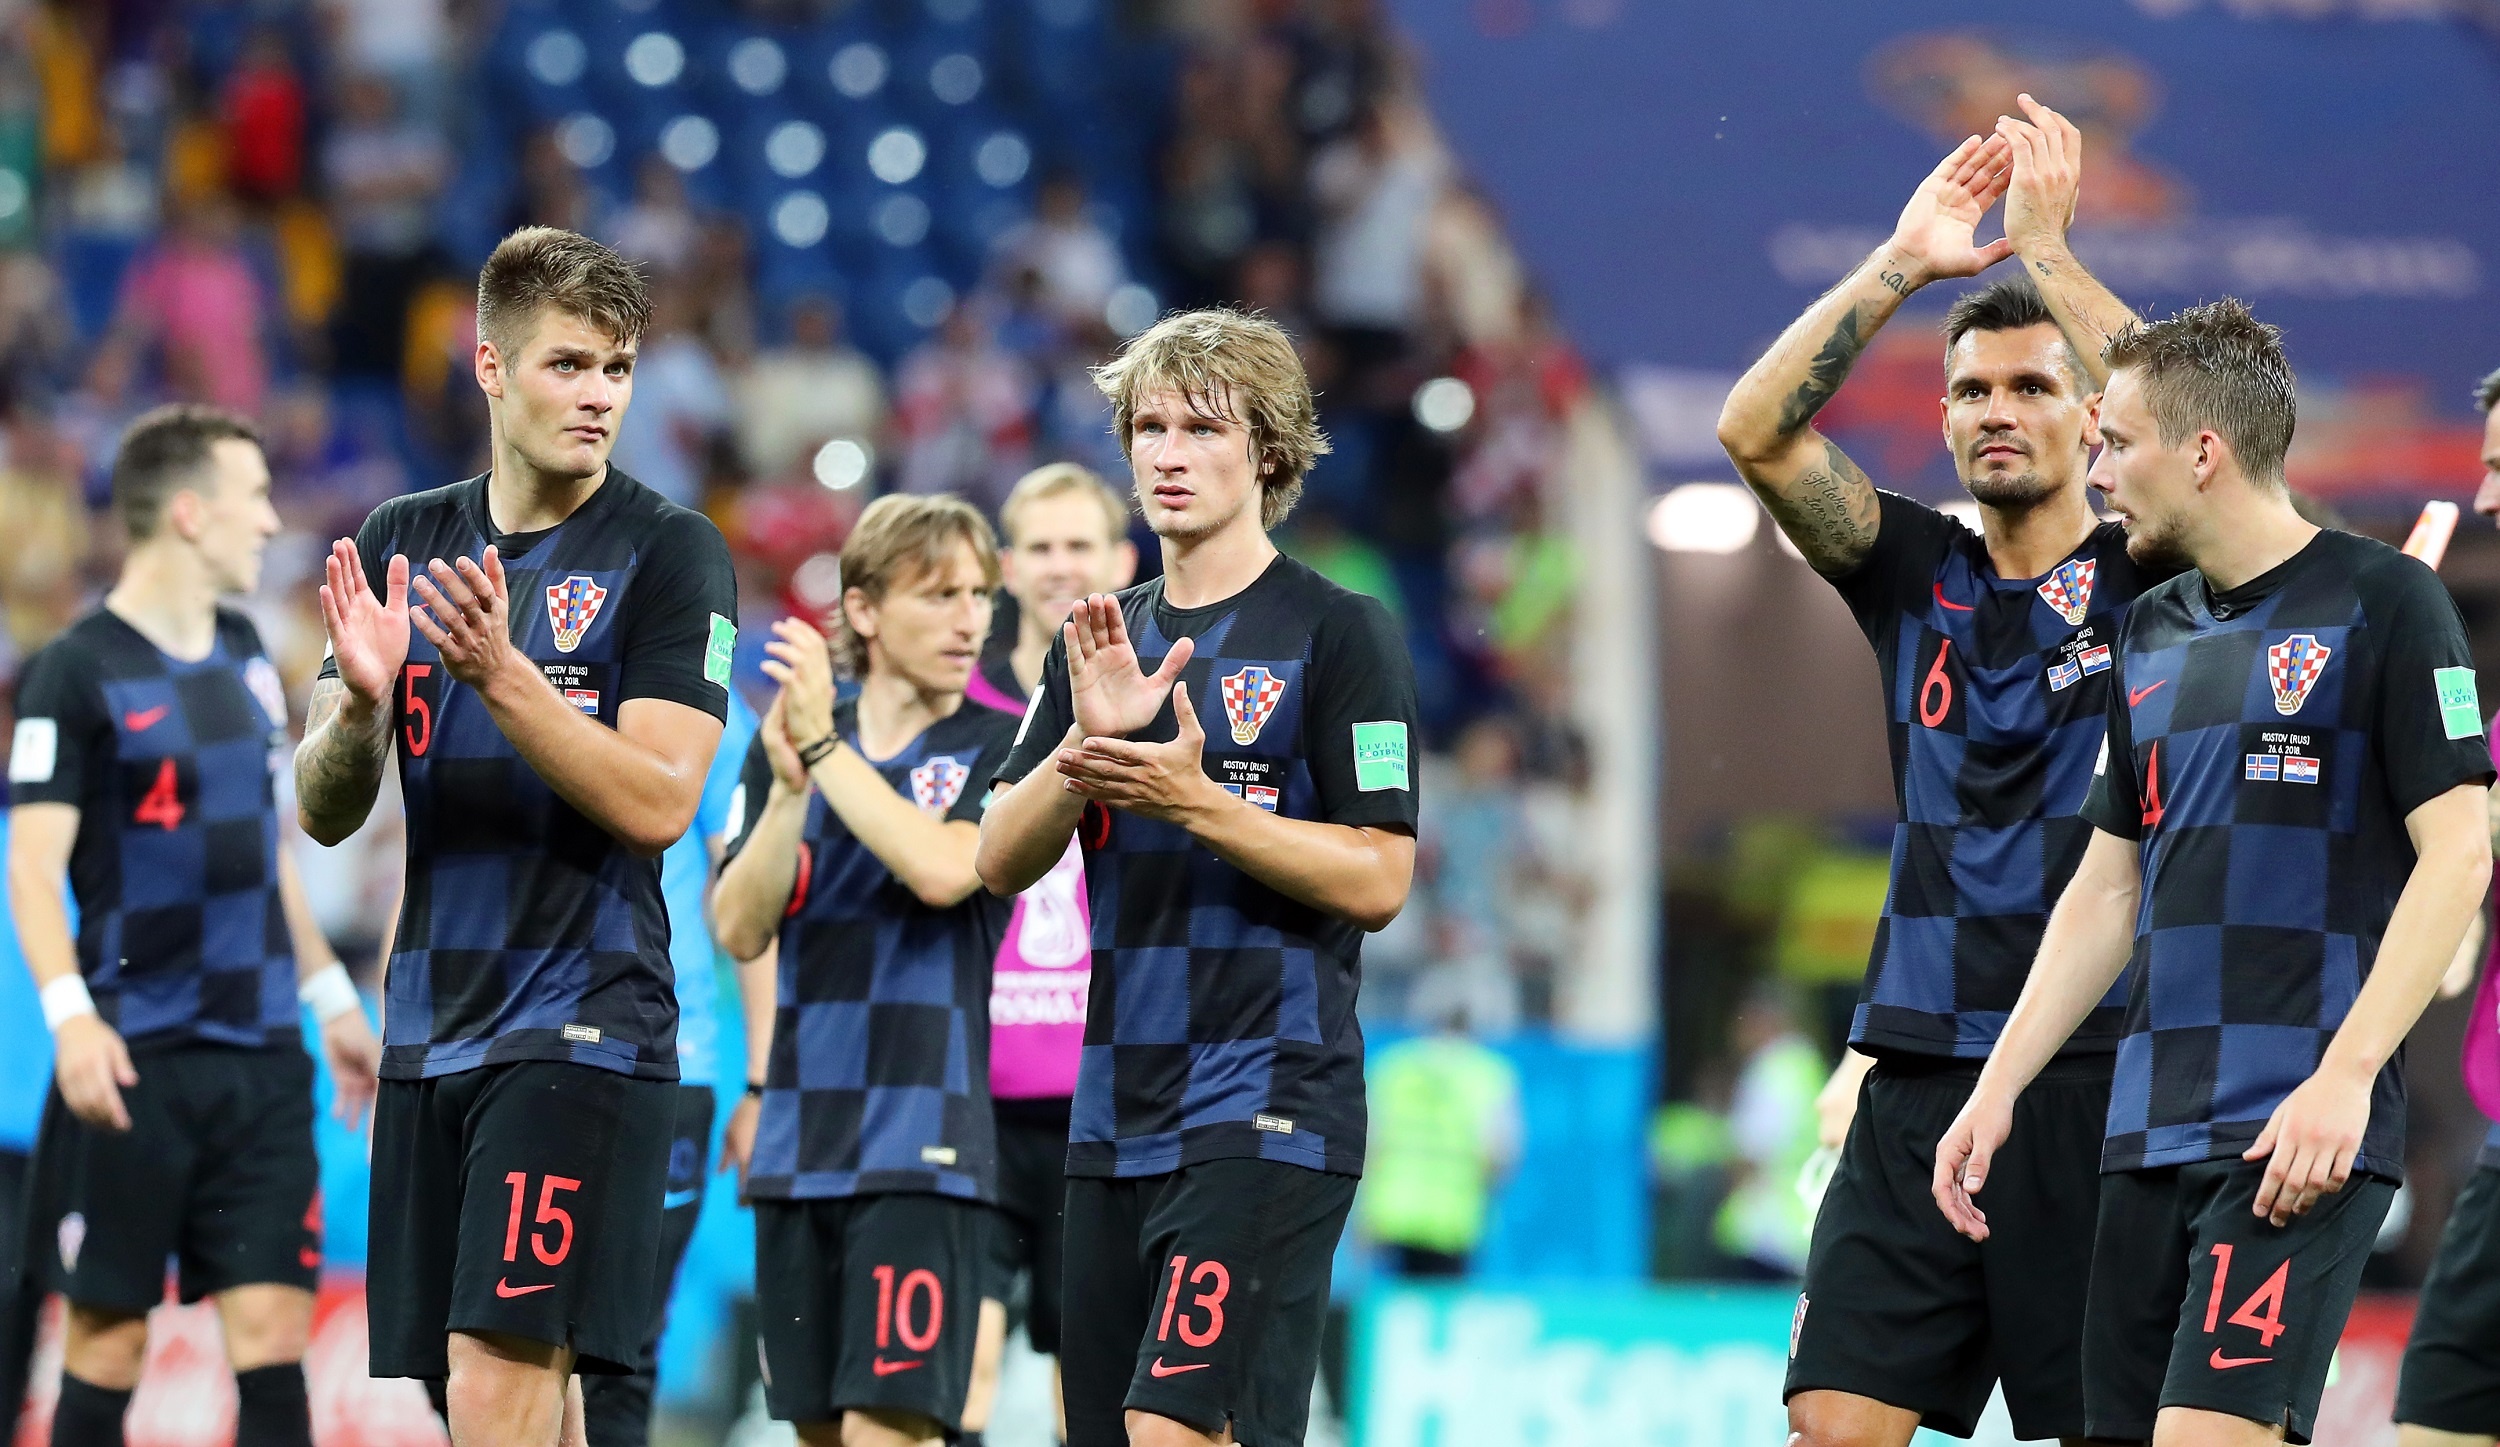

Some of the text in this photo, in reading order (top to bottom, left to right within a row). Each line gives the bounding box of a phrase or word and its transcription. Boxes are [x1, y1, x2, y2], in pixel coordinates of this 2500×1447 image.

[399, 664, 432, 757] 5
[568, 666, 588, 677] (RUS)
[1244, 675, 1259, 714] HNS
[1919, 638, 1952, 728] 6
[1223, 760, 1270, 774] ROSTOV (RUS)
[1358, 741, 1404, 751] LIVING
[1392, 762, 1405, 772] FIFA
[2261, 732, 2310, 746] ROSTOV (RUS)
[134, 758, 186, 832] 4
[2139, 740, 2166, 832] 4
[503, 1171, 582, 1267] 15
[872, 1265, 944, 1352] 10
[1157, 1255, 1231, 1348] 13
[2203, 1243, 2291, 1348] 14
